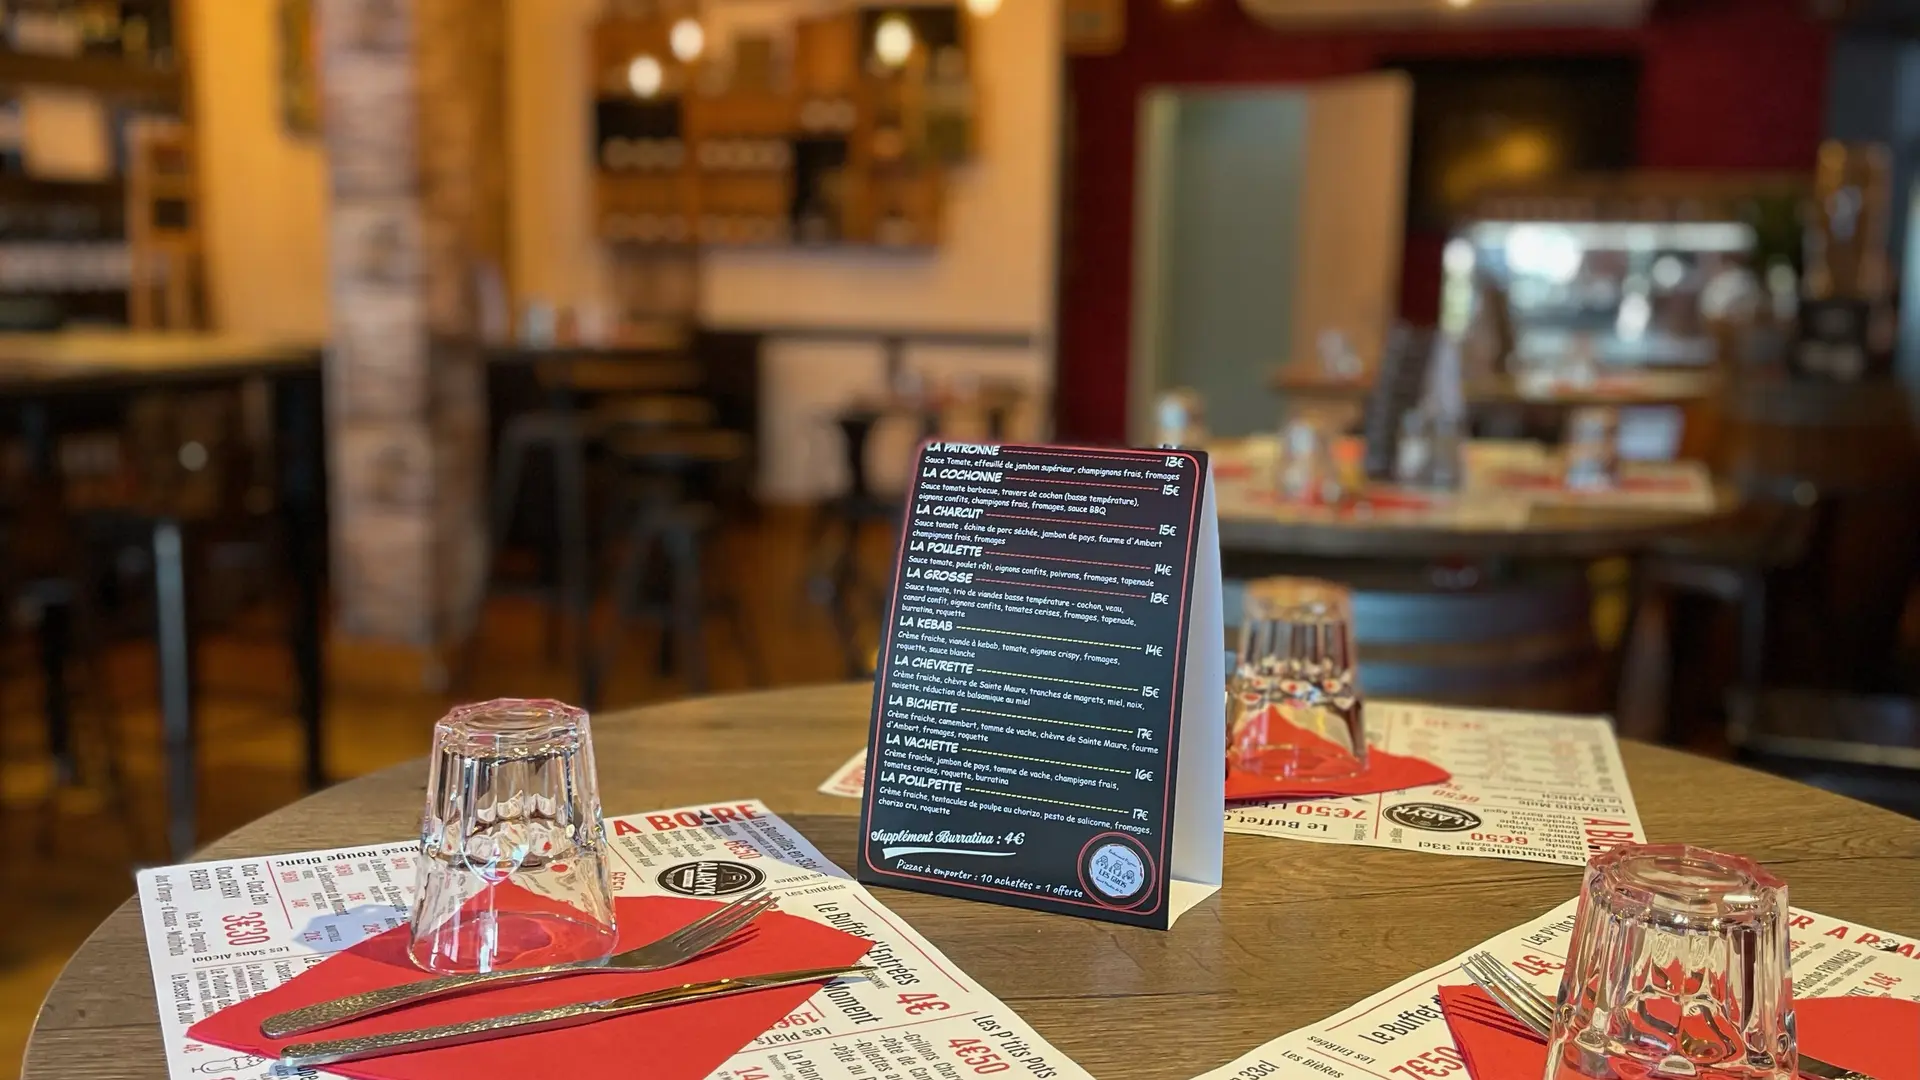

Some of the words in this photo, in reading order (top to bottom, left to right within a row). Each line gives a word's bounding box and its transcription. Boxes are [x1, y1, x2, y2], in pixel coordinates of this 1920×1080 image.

[926, 442, 941, 452] LA
[943, 442, 1001, 456] PATRONNE
[1164, 455, 1185, 468] 13€
[924, 455, 945, 464] Sauce
[946, 456, 973, 467] Tomate,
[973, 458, 1004, 468] effeuillé
[1003, 460, 1014, 469] de
[1013, 461, 1040, 471] jambon
[1040, 463, 1076, 474] supérieur,
[1076, 465, 1122, 477] champignons
[1122, 468, 1143, 479] frais,
[1144, 469, 1180, 482] fromages
[920, 480, 941, 490] Sauce
[941, 483, 966, 492] tomate
[966, 484, 1000, 496] barbecue,
[1001, 487, 1027, 497] travers
[1027, 489, 1037, 498] de
[1037, 490, 1063, 500] cochon
[1063, 491, 1087, 502] (basse
[921, 466, 937, 478] LA
[938, 467, 1003, 483] COCHONNE
[1161, 483, 1180, 496] 15€
[917, 492, 944, 502] oignons
[943, 494, 970, 504] confits,
[1010, 498, 1030, 509] frais,
[1031, 499, 1066, 512] fromages,
[1066, 504, 1088, 513] sauce
[1088, 504, 1106, 516] BBQ
[915, 503, 930, 515] LA
[1158, 523, 1177, 536] 15€
[911, 528, 953, 540] champignons
[953, 531, 973, 542] frais,
[973, 533, 1006, 546] fromages
[909, 539, 924, 552] LA
[926, 541, 983, 557] POULETTE
[1153, 562, 1172, 576] 14€
[907, 554, 928, 564] Sauce
[928, 557, 954, 567] tomate,
[954, 560, 977, 569] poulet
[977, 561, 993, 571] rôti,
[994, 564, 1021, 573] oignons
[1020, 566, 1049, 577] confits,
[1048, 570, 1081, 580] poivrons,
[1082, 571, 1119, 584] fromages,
[1120, 576, 1154, 587] tapenade
[905, 565, 921, 579] LA
[922, 568, 973, 584] GROSSE
[1149, 591, 1169, 605] 18€
[902, 593, 926, 602] canard
[925, 595, 949, 606] confit,
[949, 598, 975, 608] oignons
[975, 600, 1003, 612] confits,
[1004, 603, 1033, 614] tomates
[1033, 608, 1062, 618] cerises,
[1063, 609, 1099, 622] fromages,
[1100, 614, 1136, 627] tapenade,
[898, 614, 914, 627] LA
[916, 616, 953, 631] KEBAB
[1144, 643, 1163, 657] 14€
[895, 642, 928, 653] roquette,
[928, 646, 948, 655] sauce
[948, 647, 975, 658] blanche
[893, 653, 909, 666] LA
[910, 656, 974, 674] CHEVRETTE
[1141, 685, 1160, 698] 15€
[890, 681, 921, 692] noisette,
[921, 684, 955, 696] réduction
[955, 688, 966, 697] de
[966, 689, 1004, 703] balsamique
[1004, 696, 1014, 704] au
[1014, 697, 1031, 706] miel
[887, 693, 903, 706] LA
[905, 696, 958, 714] BICHETTE
[1136, 727, 1153, 741] 17€
[885, 720, 921, 733] d'Ambert,
[921, 724, 956, 738] fromages,
[957, 731, 988, 742] roquette
[885, 732, 900, 745] LA
[903, 735, 959, 753] VACHETTE
[1134, 767, 1153, 782] 16€
[883, 759, 912, 771] tomates
[911, 764, 940, 776] cerises,
[940, 769, 974, 781] roquette,
[974, 772, 1009, 785] burratina
[880, 770, 895, 783] LA
[897, 773, 962, 793] POULPETTE
[1131, 807, 1149, 821] 17€
[1239, 816, 1300, 829] Buffet
[1295, 804, 1368, 821] 7€50
[1393, 806, 1481, 827] ALARYK
[613, 820, 643, 836] A
[870, 829, 934, 845] Supplément
[935, 830, 995, 845] Burratina
[1004, 831, 1026, 845] 4€
[1307, 822, 1328, 832] Le
[723, 840, 763, 859] 6€50
[1418, 841, 1451, 851] 33cl
[1456, 842, 1475, 851] en
[1470, 832, 1529, 846] 6€50
[276, 857, 322, 868] Blanc
[327, 850, 378, 863] Rouge
[381, 845, 420, 858] Rosé
[1479, 846, 1557, 860] Bouteilles
[1562, 854, 1586, 863] Les
[694, 862, 719, 895] ALARYK
[895, 858, 923, 872] Pizzas
[924, 863, 931, 873] à
[932, 867, 972, 879] emporter
[980, 873, 993, 883] 10
[993, 875, 1033, 890] achetées
[1052, 884, 1083, 898] offerte
[813, 902, 838, 913] Le
[222, 912, 271, 946] 3€30
[825, 912, 874, 938] Buffet
[867, 940, 920, 986] 'Entrées
[1511, 954, 1566, 977] 4€
[822, 981, 883, 1025] Moment
[896, 993, 951, 1016] 4€
[802, 1026, 832, 1035] Les
[1358, 1030, 1395, 1045] Le
[1381, 1003, 1437, 1036] Buffet
[948, 1038, 1011, 1075] 4€50
[972, 1014, 1001, 1032] Les
[990, 1030, 1031, 1058] P'tits
[1020, 1056, 1058, 1079] Pots
[1281, 1049, 1304, 1062] Les
[847, 1063, 867, 1078] au
[897, 1053, 917, 1067] de
[1238, 1059, 1280, 1080] 33cl
[1354, 1053, 1377, 1065] Les
